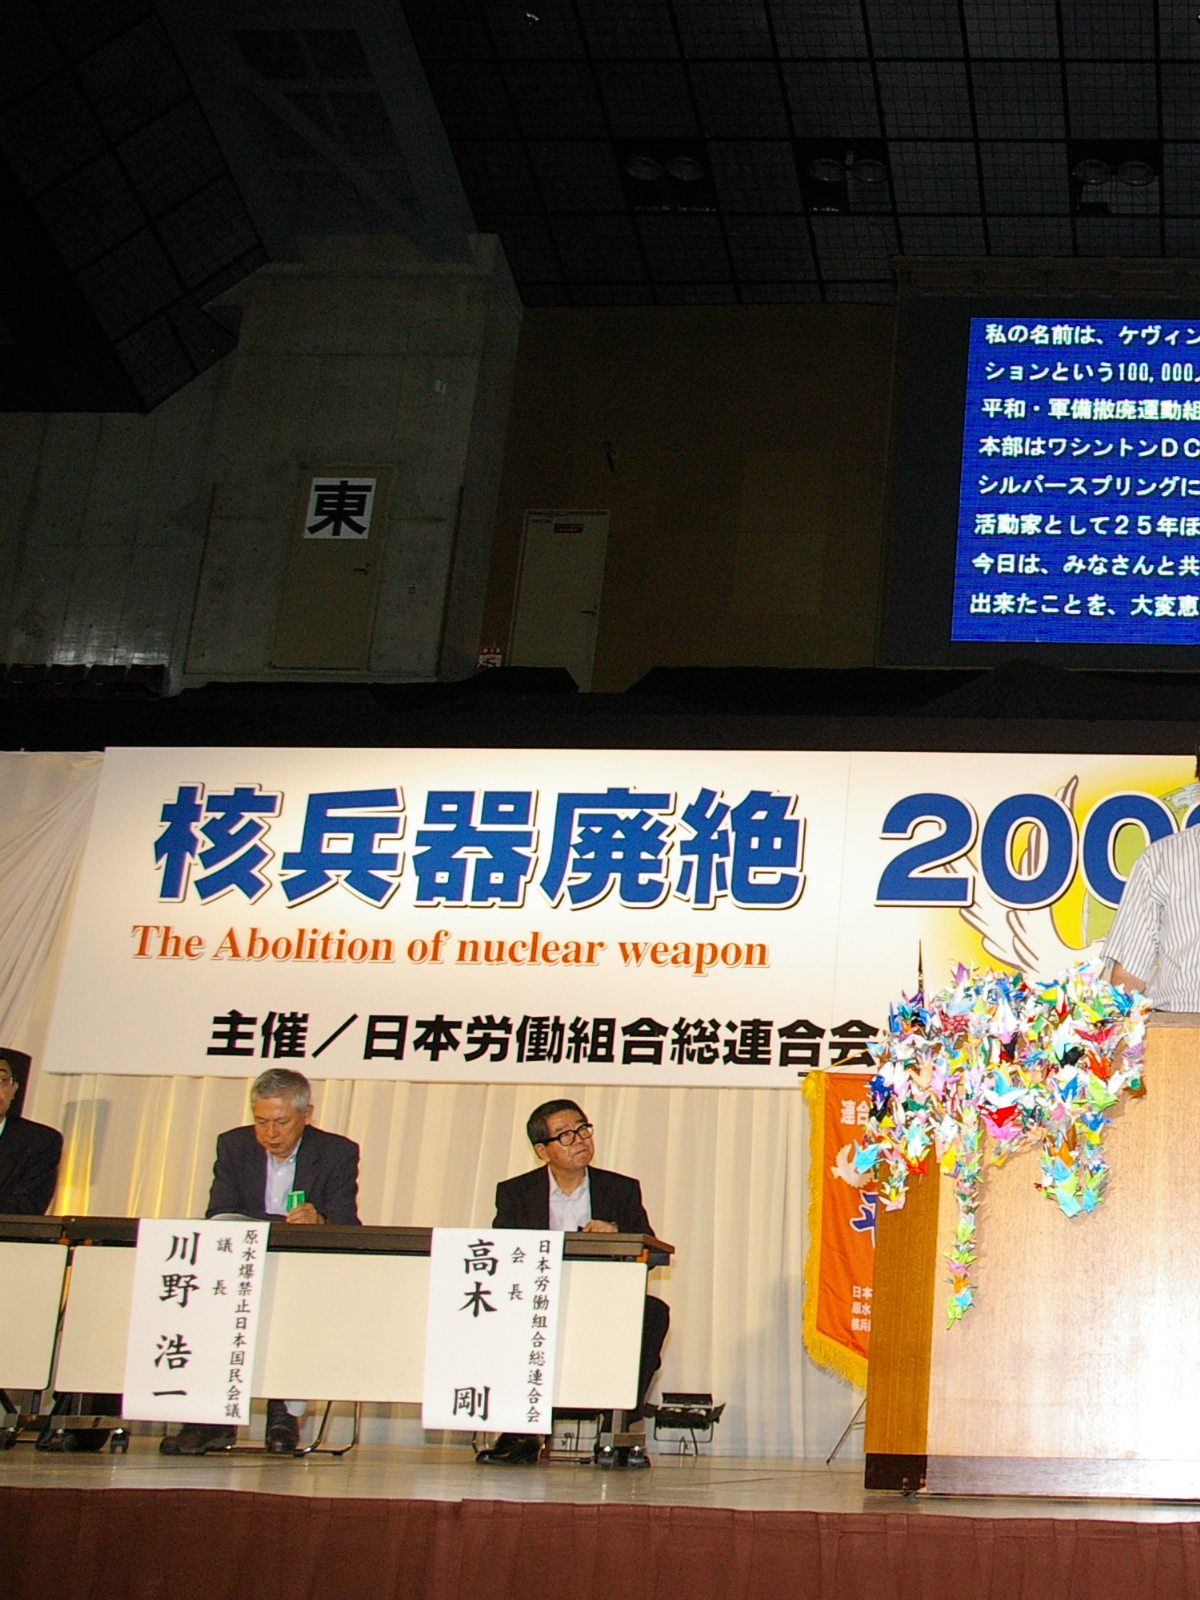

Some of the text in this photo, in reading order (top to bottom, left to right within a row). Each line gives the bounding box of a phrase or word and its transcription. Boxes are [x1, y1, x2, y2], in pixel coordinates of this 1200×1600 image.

[307, 481, 372, 536] 東
[154, 783, 806, 910] 核兵器廃絶
[132, 924, 771, 978] The Abolition of nuclear weapon
[212, 1237, 233, 1296] 議長
[508, 1246, 527, 1301] 会長
[225, 1229, 259, 1419] 原水爆禁止日本国民会議
[525, 1239, 551, 1423] 日本労働組合総連合会
